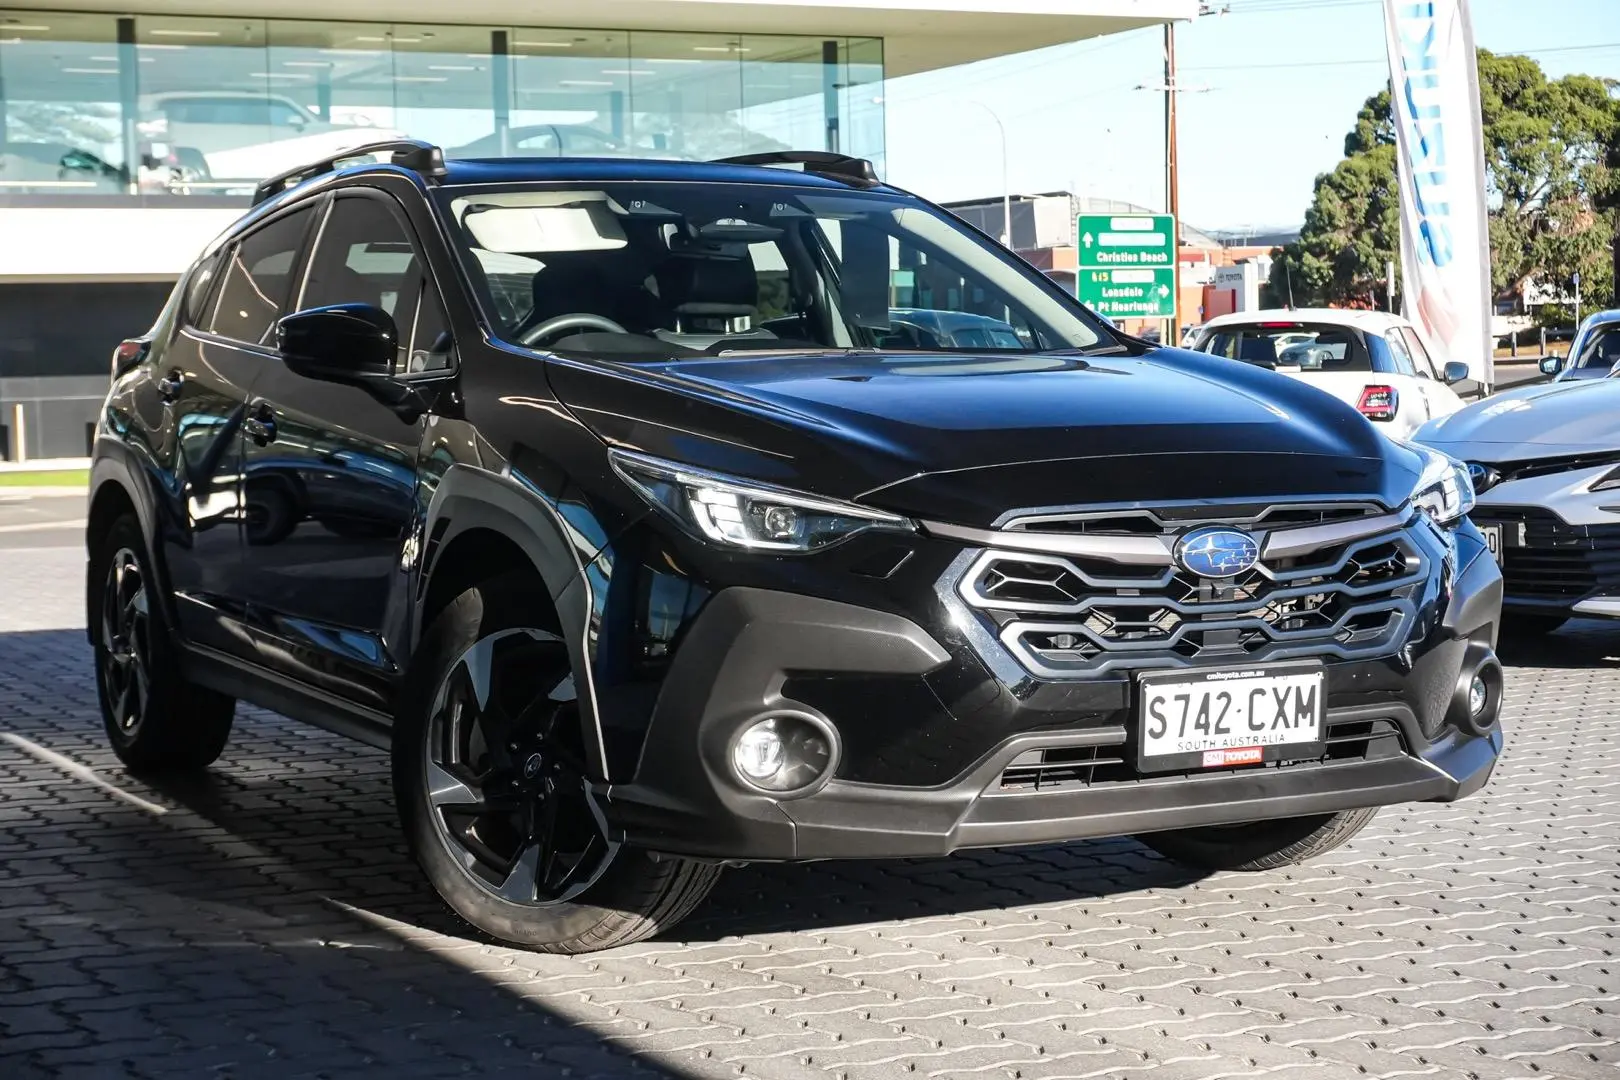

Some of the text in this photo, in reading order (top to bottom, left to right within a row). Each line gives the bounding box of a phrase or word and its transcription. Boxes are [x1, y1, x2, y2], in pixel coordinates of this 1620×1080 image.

[1096, 251, 1168, 263] Christies Beach
[1102, 286, 1143, 298] Lonsdale
[1098, 301, 1109, 312] Pt
[1206, 670, 1265, 681] cmitoyota.com.au
[1177, 733, 1286, 751] SOUTH AUSTRALIA
